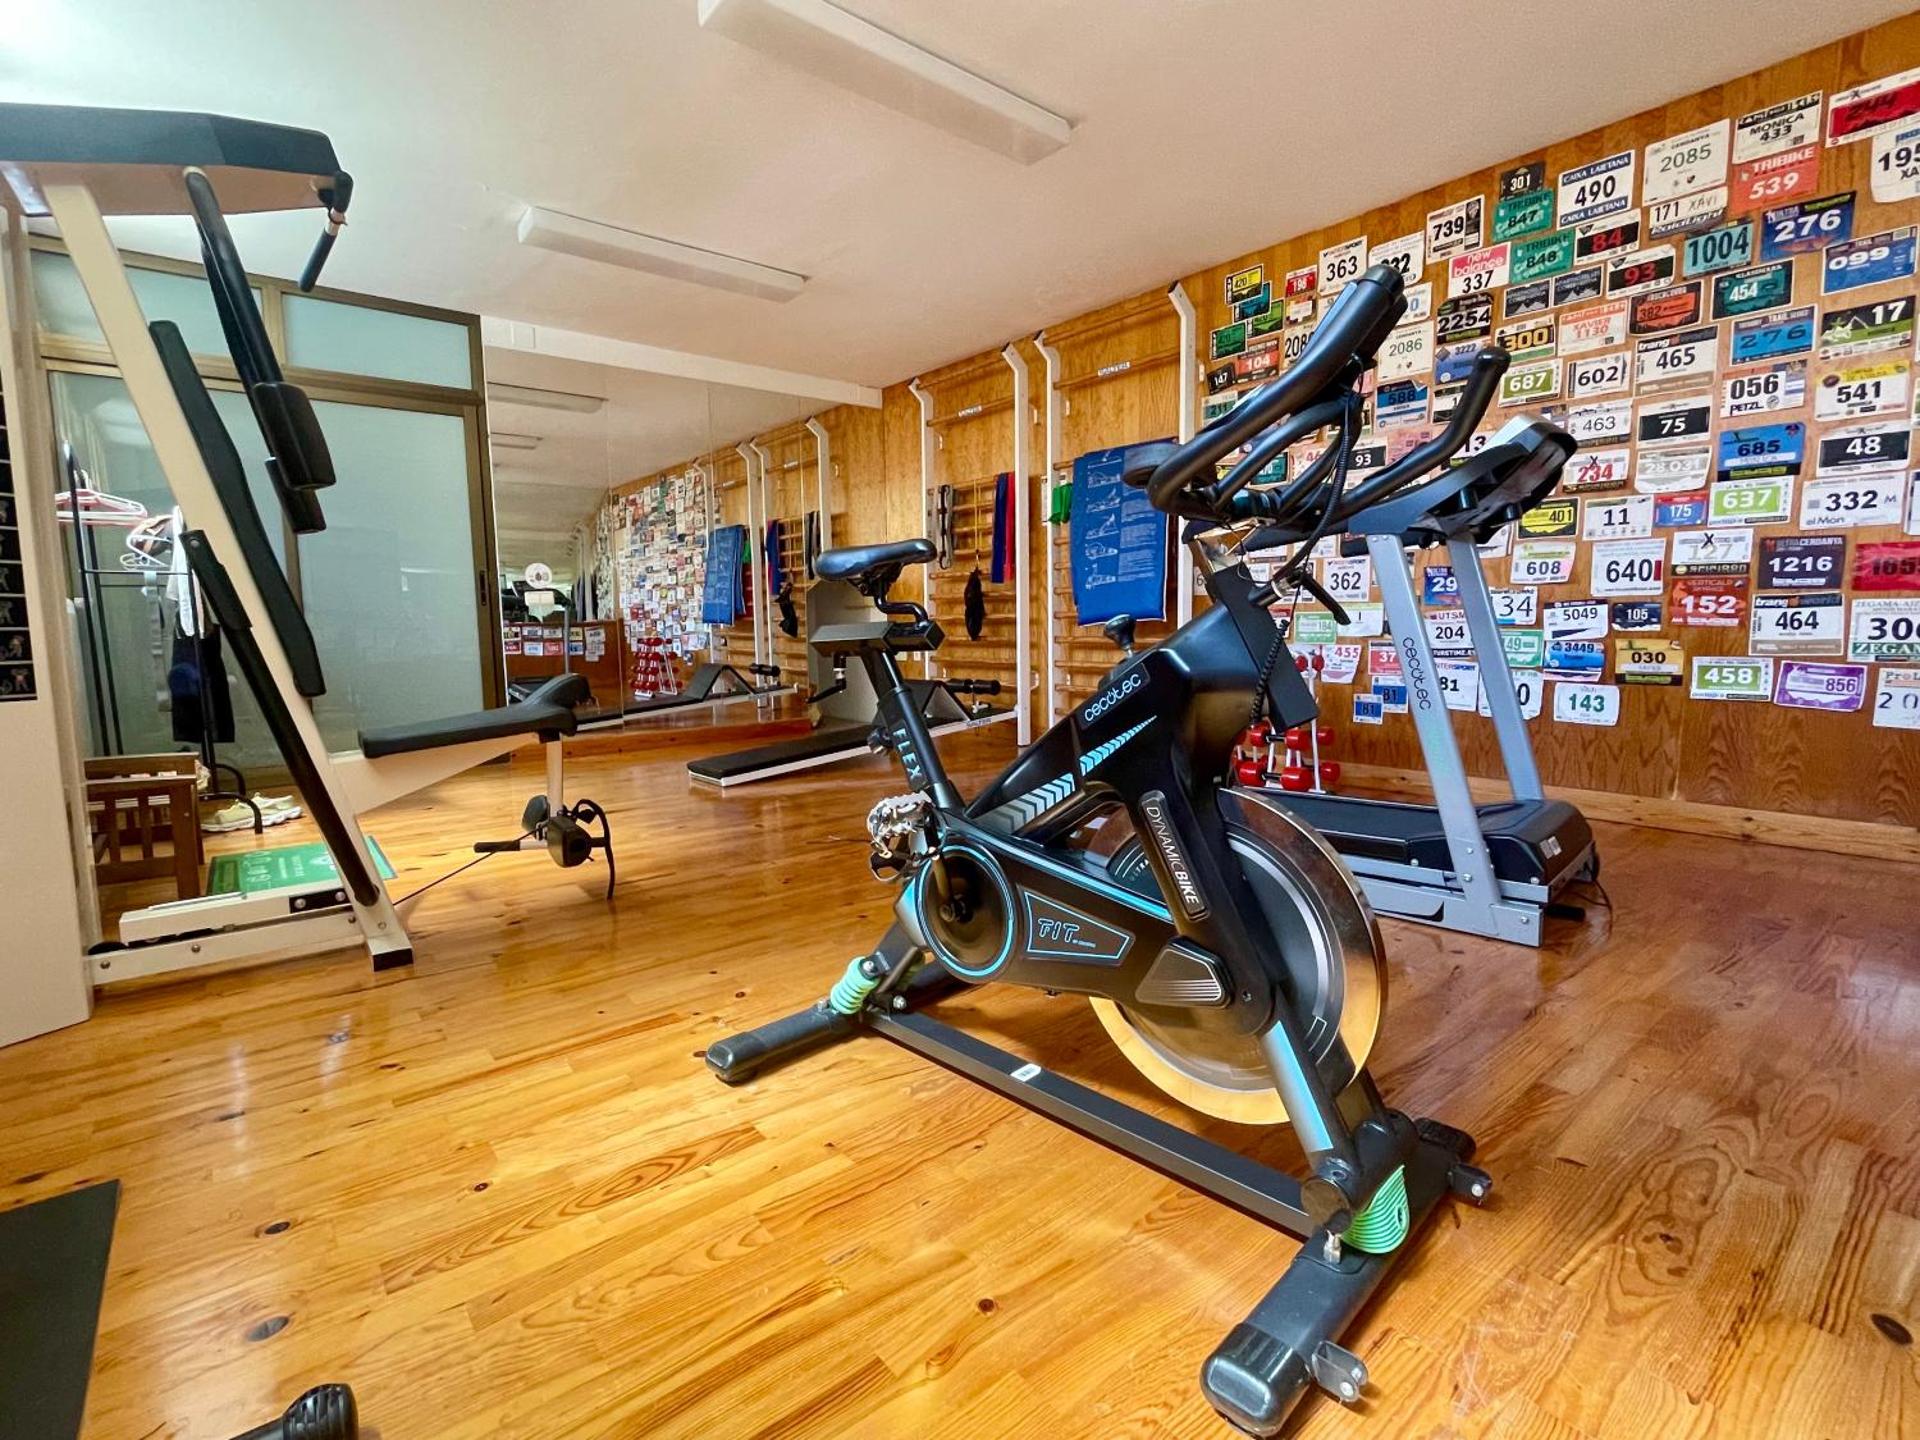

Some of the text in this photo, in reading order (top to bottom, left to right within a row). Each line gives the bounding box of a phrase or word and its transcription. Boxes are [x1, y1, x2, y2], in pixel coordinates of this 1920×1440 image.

[1750, 112, 1805, 135] MONICA
[1759, 125, 1792, 142] 433
[1660, 143, 1711, 173] 2085
[1752, 147, 1815, 173] TRIBIKE
[1562, 156, 1630, 186] CAIXA LAIETANA
[1510, 174, 1531, 191] 301
[1575, 175, 1616, 207] 490
[1749, 172, 1799, 199] 539
[1508, 209, 1537, 228] 847
[1561, 199, 1626, 225] CAIXA LAIETANA
[1655, 201, 1680, 223] 171
[1433, 217, 1464, 241] 739
[1774, 209, 1841, 242] 276
[1592, 229, 1624, 252] 84
[1690, 227, 1748, 267] 1004
[1454, 255, 1504, 277] balance
[1466, 251, 1491, 265] new
[1526, 250, 1557, 269] 848
[1829, 246, 1890, 270] 099
[1326, 256, 1357, 282] 363
[1624, 263, 1656, 286] 93
[1462, 271, 1494, 294] 337
[1730, 283, 1758, 301] 454
[1438, 308, 1491, 334] 2254
[1872, 301, 1906, 325] 17
[1389, 338, 1423, 357] 2086
[1503, 328, 1549, 352] 300
[1740, 326, 1806, 349] 276
[1246, 356, 1270, 369] 104
[1656, 347, 1695, 370] 465
[1214, 373, 1228, 386] 147
[1509, 372, 1547, 392] 687
[1578, 366, 1619, 386] 602
[1730, 374, 1779, 399] 056
[1836, 381, 1881, 403] 541
[1730, 401, 1764, 416] PETZL
[1583, 416, 1616, 432] 463
[1661, 417, 1686, 434] 75
[1737, 440, 1781, 457] 685
[1846, 436, 1881, 456] 48
[1354, 454, 1371, 466] 93
[1578, 464, 1614, 482] 234
[1723, 489, 1772, 508] 637
[1825, 491, 1878, 511] 332
[1550, 509, 1572, 522] 401
[1603, 508, 1630, 526] 11
[1669, 504, 1692, 519] 175
[1526, 561, 1561, 576] 608
[1606, 559, 1653, 583] 640
[1768, 556, 1833, 573] 1216
[1330, 571, 1361, 590] 362
[1563, 607, 1598, 622] 5049
[1627, 608, 1648, 620] 105
[1681, 595, 1737, 614] 152
[1776, 611, 1819, 631] 464
[1435, 626, 1465, 640] 204
[1335, 647, 1359, 658] 455
[1564, 642, 1594, 654] 3449
[1631, 652, 1666, 664] 030
[1403, 636, 1431, 711] cecotec
[1705, 668, 1753, 684] 458
[1826, 678, 1856, 693] 856
[1084, 673, 1142, 723] cecotec
[1569, 693, 1605, 713] 143
[1362, 705, 1376, 714] 81
[893, 727, 922, 781] FLEX
[1037, 918, 1080, 943] FIT
